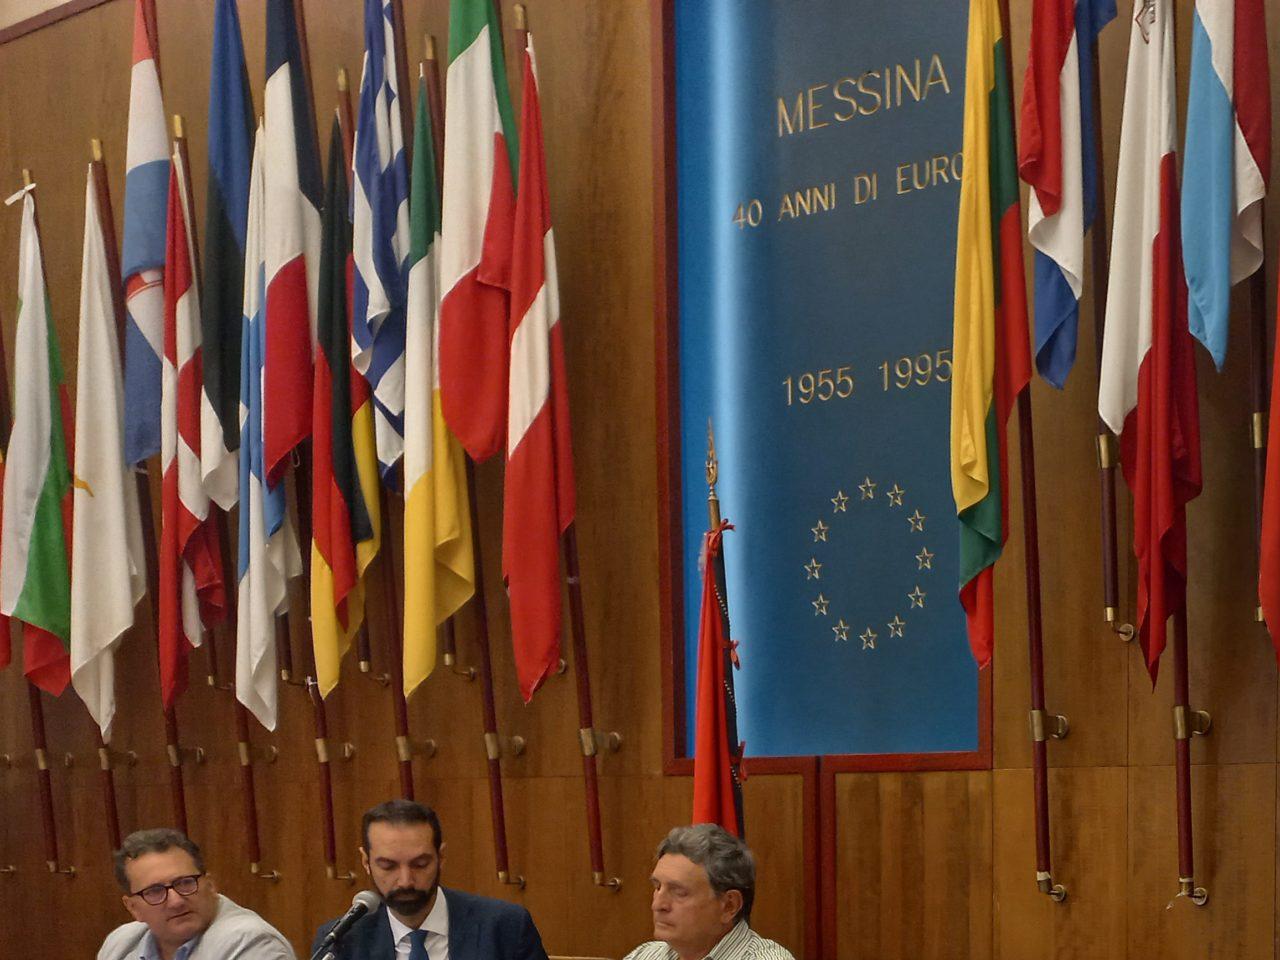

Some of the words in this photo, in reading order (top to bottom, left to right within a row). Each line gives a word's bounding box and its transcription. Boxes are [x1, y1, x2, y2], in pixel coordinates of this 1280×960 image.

[776, 53, 951, 138] MESSINA
[732, 199, 763, 231] 40
[777, 182, 836, 221] ANNI
[854, 172, 878, 206] DI
[782, 366, 854, 406] 1955
[878, 349, 952, 392] 1995
